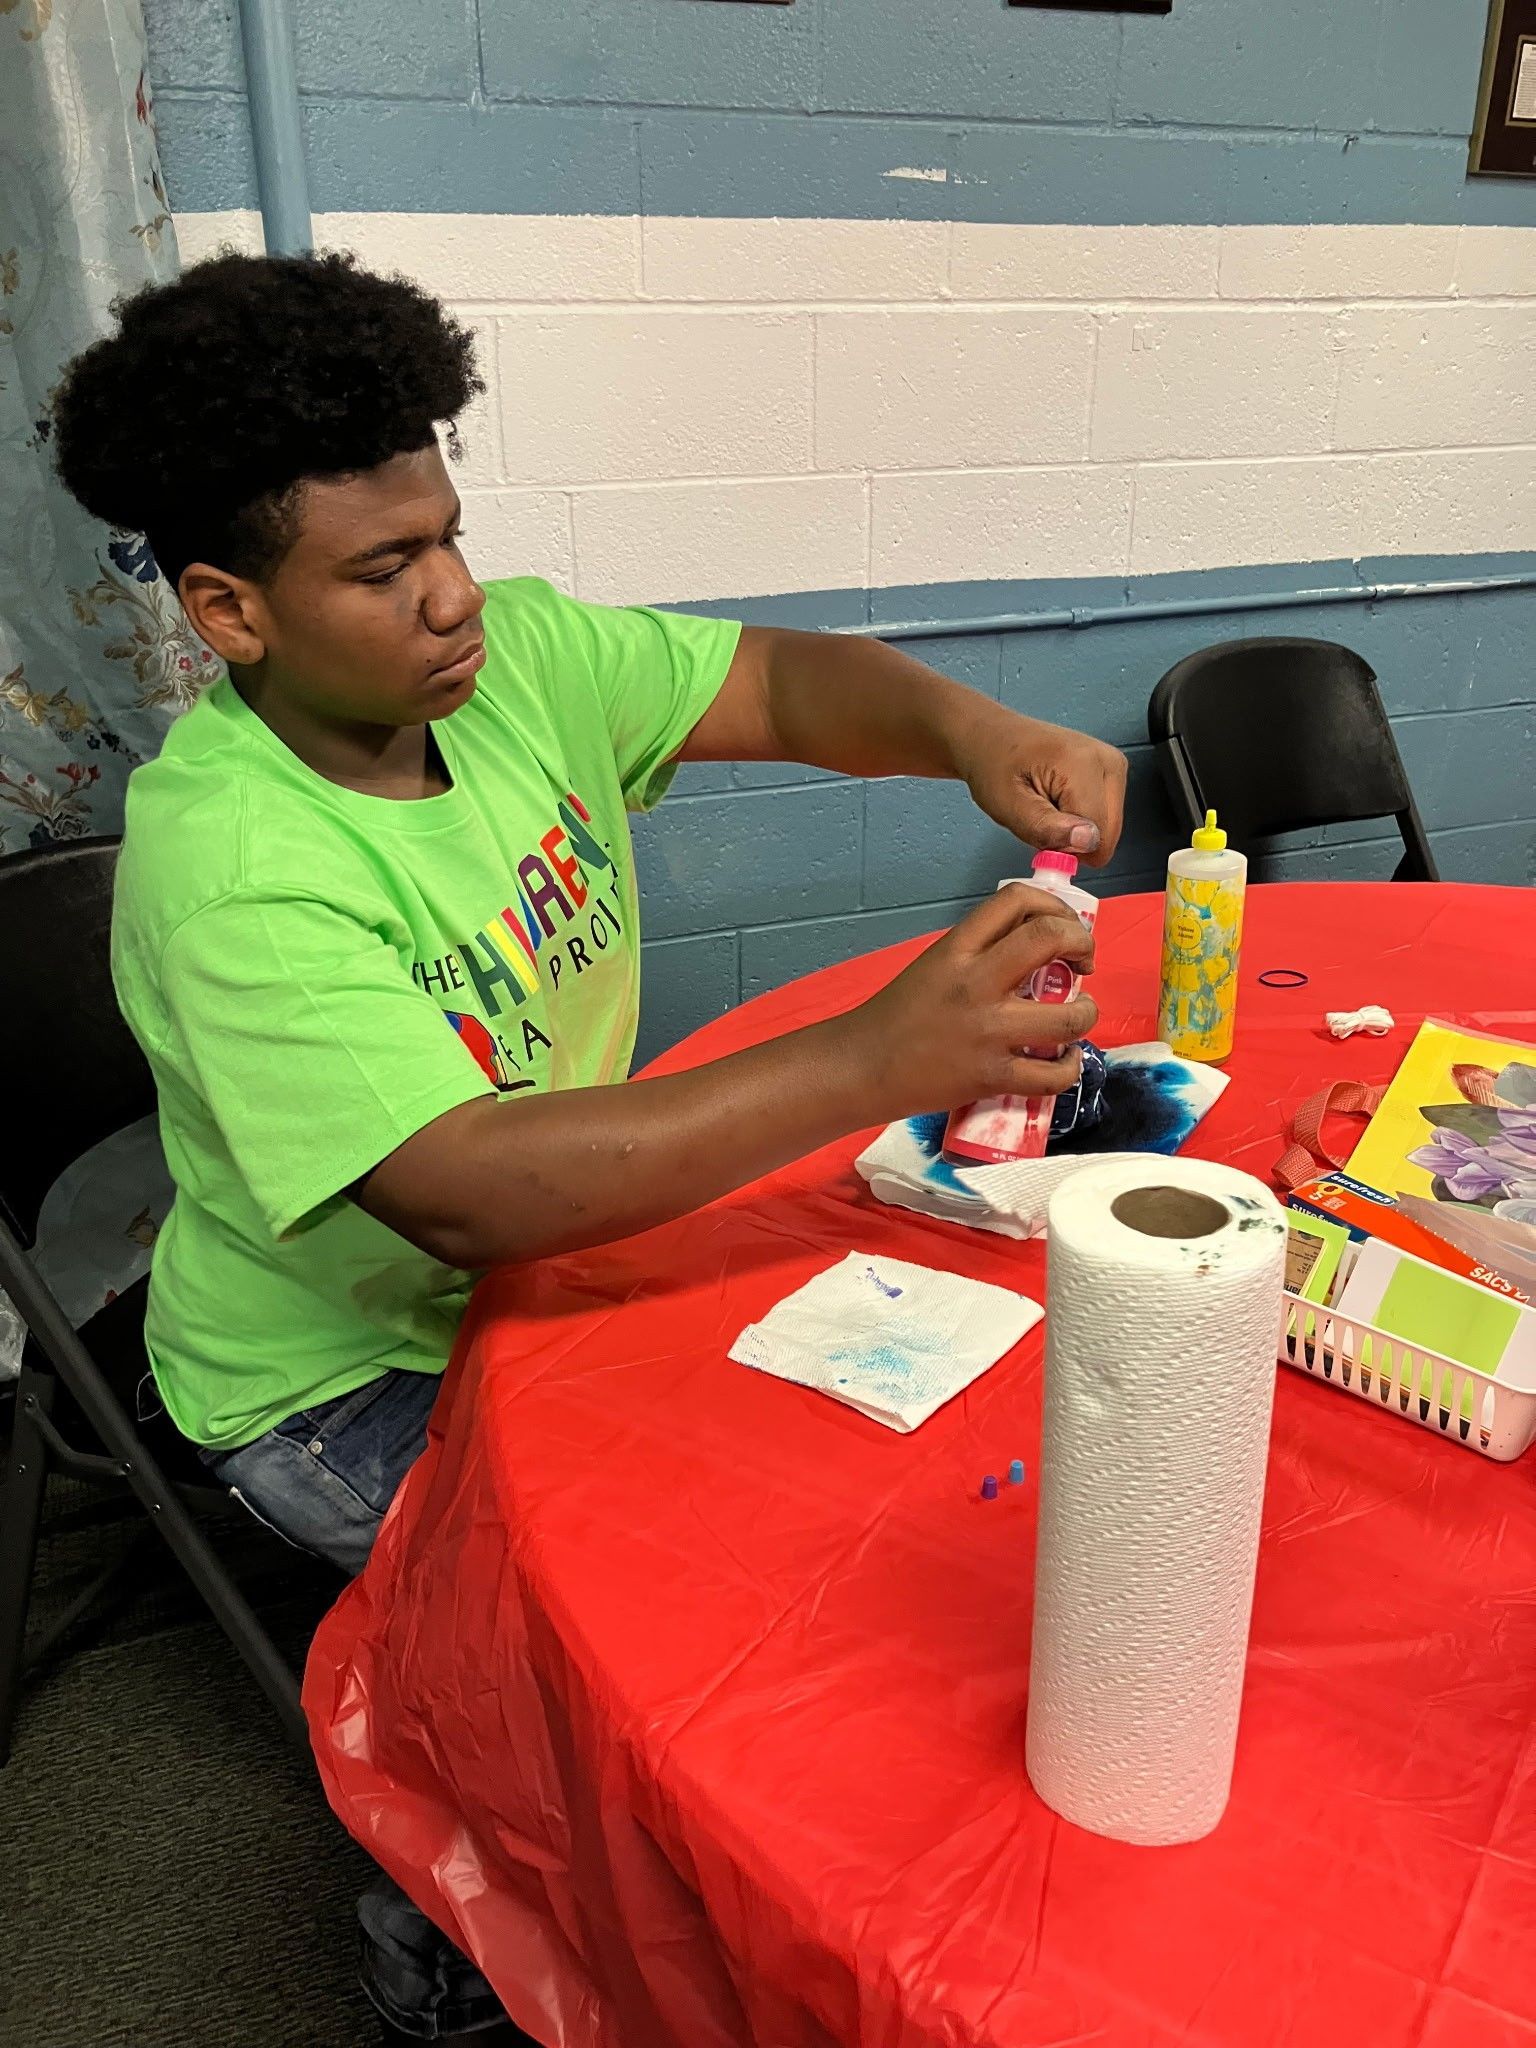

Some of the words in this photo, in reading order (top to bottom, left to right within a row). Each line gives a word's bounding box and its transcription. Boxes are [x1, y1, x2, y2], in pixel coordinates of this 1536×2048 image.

[412, 954, 465, 996] THE
[1047, 975, 1062, 984] Pink
[1331, 1175, 1392, 1203] surefresh
[1470, 1267, 1512, 1293] SACS
